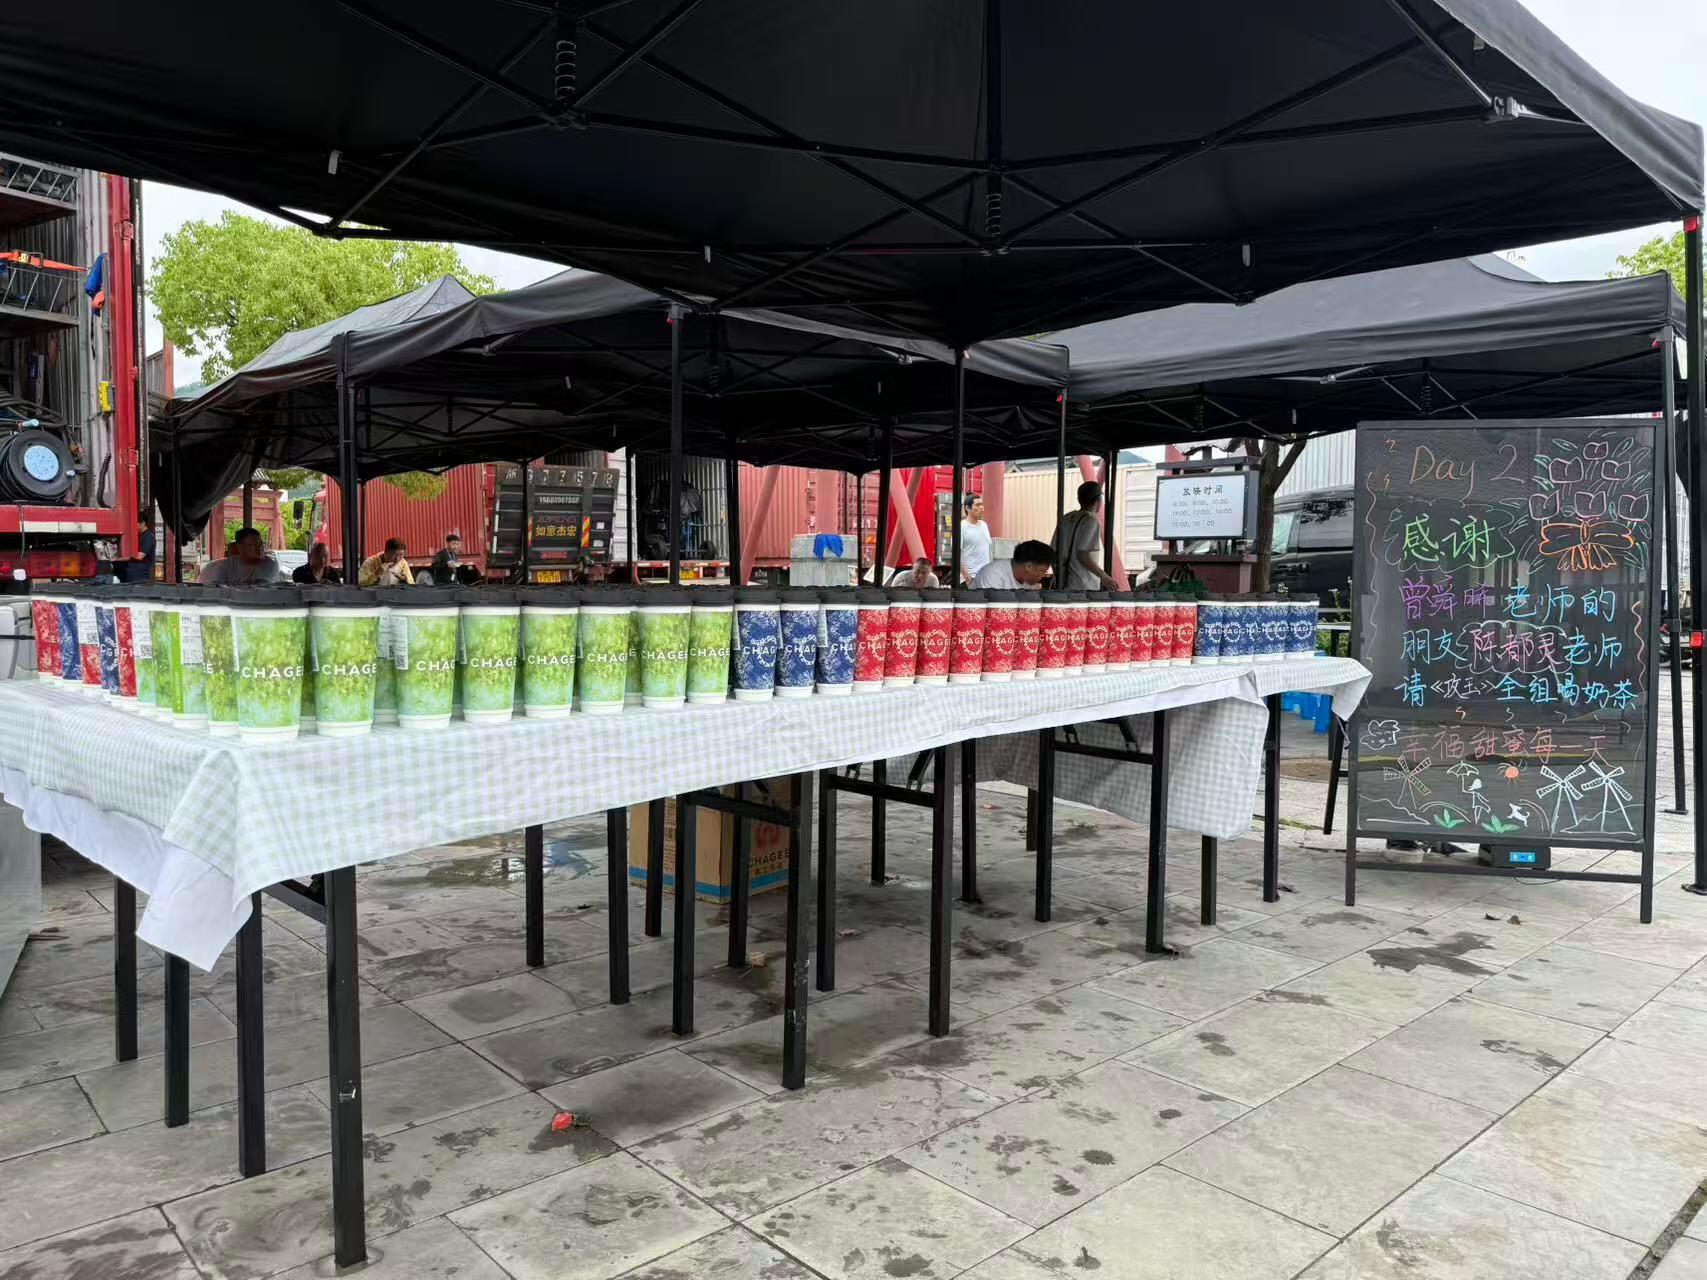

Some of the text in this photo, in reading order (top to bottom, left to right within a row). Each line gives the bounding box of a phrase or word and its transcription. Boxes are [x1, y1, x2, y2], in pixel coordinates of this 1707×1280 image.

[1409, 444, 1524, 500] Day 2
[1402, 512, 1496, 562] 感谢
